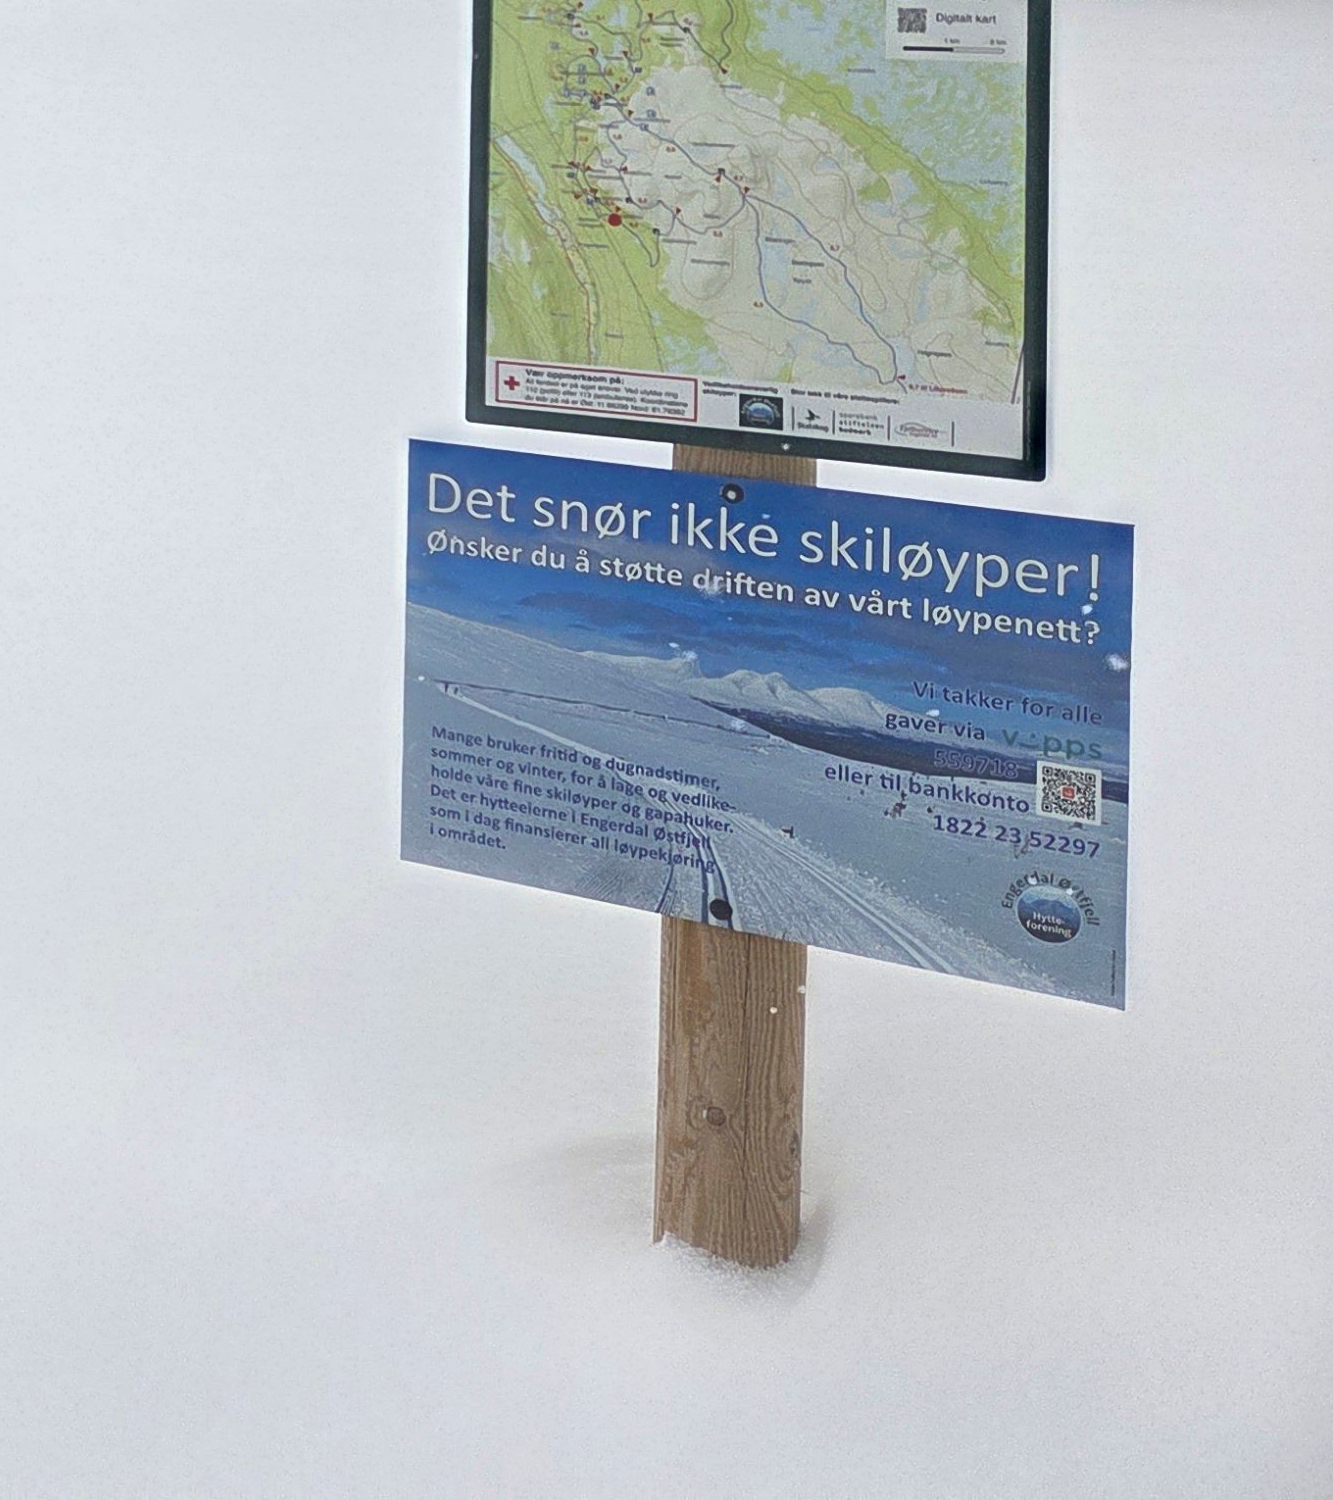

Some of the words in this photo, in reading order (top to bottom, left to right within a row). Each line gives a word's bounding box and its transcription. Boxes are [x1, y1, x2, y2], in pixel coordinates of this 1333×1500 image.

[936, 13, 972, 25] Digitalt
[975, 13, 997, 24] kart
[428, 471, 516, 524] Det
[533, 493, 652, 543] snør
[670, 501, 778, 559] ikke
[801, 520, 1101, 602] skiløyper!
[427, 528, 522, 565] Ønsker
[531, 541, 568, 571] du
[574, 546, 591, 576] å
[598, 557, 684, 590] støtte
[692, 567, 796, 604] driften
[804, 588, 841, 611] av
[849, 587, 913, 621] vårt
[922, 602, 1101, 647] løypenett?
[885, 713, 947, 736] gaver
[953, 722, 985, 741] via
[913, 681, 935, 700] Vi
[943, 686, 1014, 712] takker
[1021, 697, 1054, 715] for
[1061, 704, 1103, 726] alle
[430, 747, 492, 768] sommer
[496, 758, 514, 775] og
[518, 760, 567, 784] vinter,
[570, 769, 594, 788] for
[597, 773, 607, 790] å
[611, 776, 644, 799] lage
[647, 786, 667, 803] og
[671, 786, 737, 813] vedlike-
[432, 725, 483, 747] Mange
[486, 734, 535, 756] bruker
[539, 743, 578, 764] fritid
[582, 753, 601, 770] og
[605, 756, 721, 792] dugnadstimer,
[933, 749, 1020, 779] 559718
[430, 763, 473, 785] holde
[476, 772, 509, 790] våre
[512, 777, 542, 797] fine
[546, 784, 616, 812] skiløyper
[621, 802, 641, 820] og
[644, 803, 734, 834] gapahuker.
[824, 764, 873, 788] eller
[880, 771, 902, 792] til
[908, 777, 1031, 814] bankkonto
[429, 783, 457, 801] Det
[460, 791, 476, 804] er
[479, 791, 567, 823] hytteeierne
[580, 811, 649, 840] Engerdal
[653, 824, 711, 851] Østfjell
[429, 805, 462, 821] som
[473, 808, 501, 831] dag
[504, 816, 587, 847] finansierer
[590, 831, 610, 849] all
[614, 835, 715, 875] løypekjøring
[438, 826, 507, 851] området.
[933, 815, 988, 839] 1822
[994, 824, 1022, 846] 23
[1029, 831, 1101, 860] 52297
[1026, 919, 1072, 939] forening
